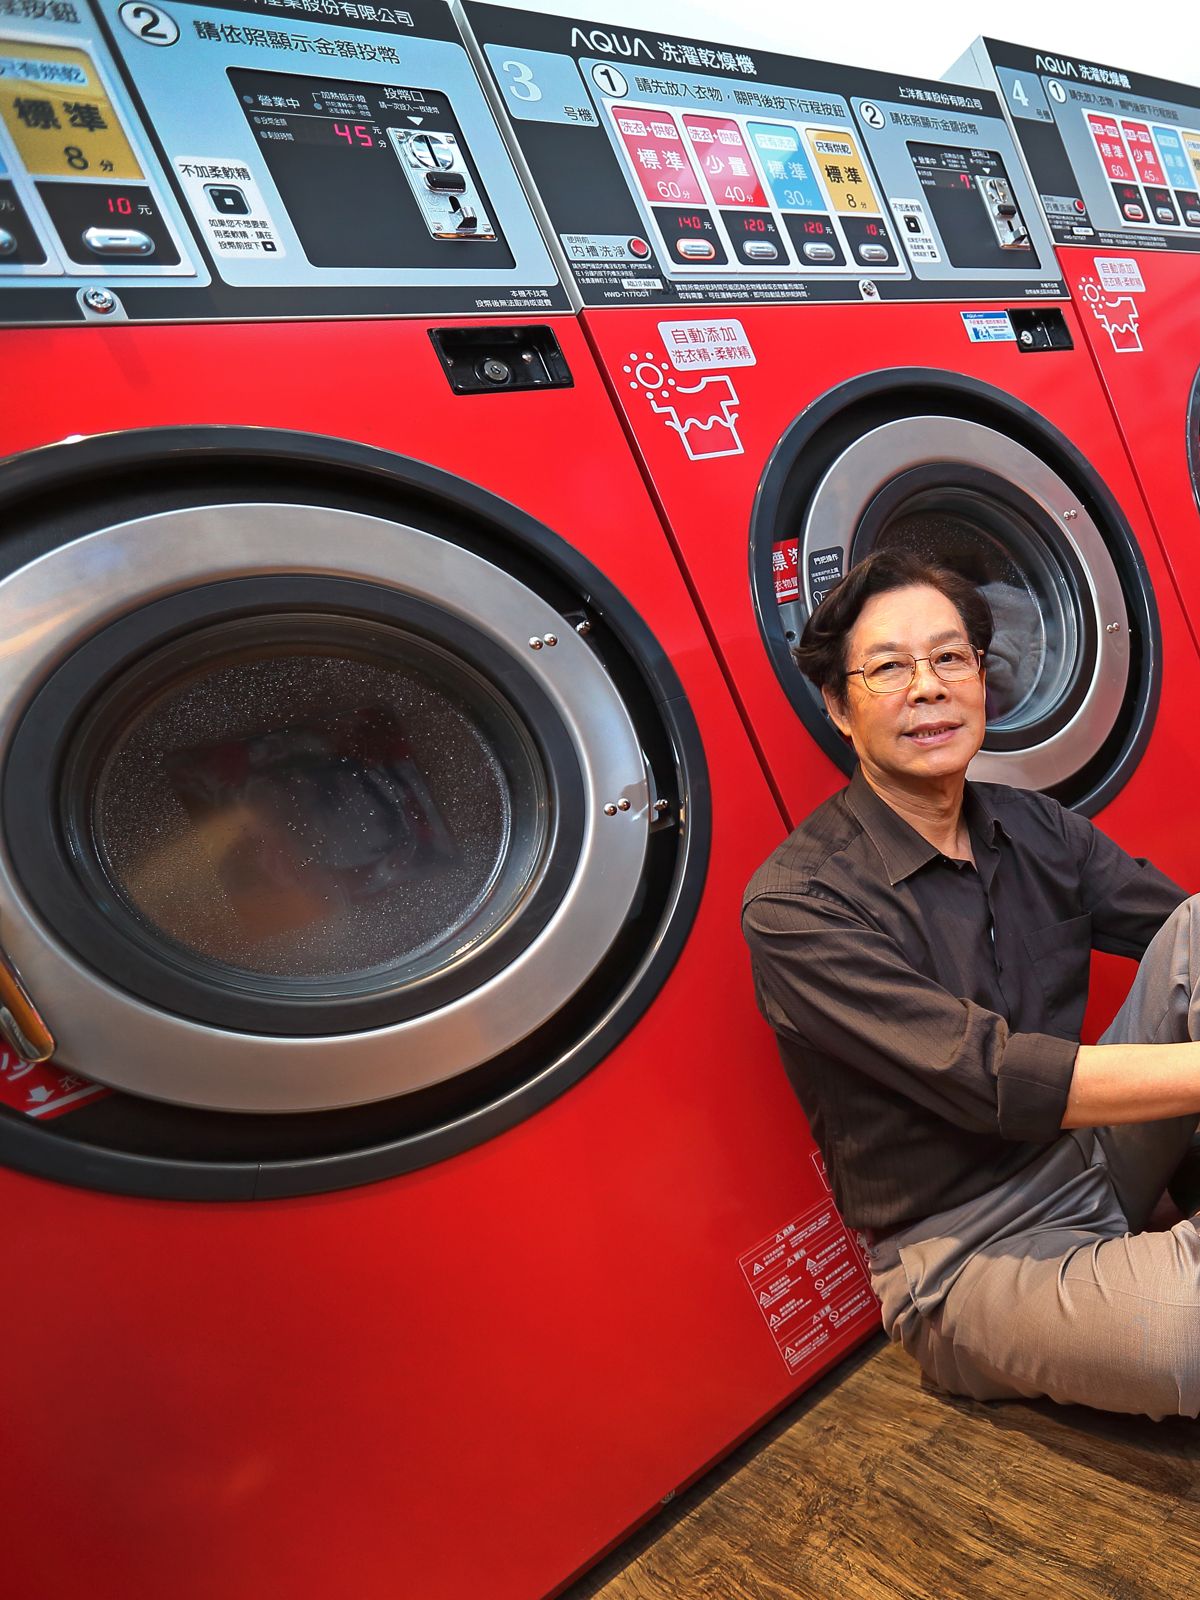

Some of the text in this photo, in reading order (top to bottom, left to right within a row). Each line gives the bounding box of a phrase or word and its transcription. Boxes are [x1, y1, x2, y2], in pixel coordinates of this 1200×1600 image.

[133, 7, 401, 65] 2 請依照顯示金額投幣
[571, 27, 758, 75] AQUA 洗濯乾燥機
[502, 60, 543, 101] 3
[1036, 54, 1131, 89] AQUA 洗濯乾燥機
[257, 94, 300, 109] 營業中
[383, 87, 426, 103] 投幣口
[1012, 79, 1029, 107] 4
[13, 97, 108, 131] 標準
[889, 111, 979, 136] 請依照顯示金額投幣
[334, 123, 373, 146] 45
[64, 146, 89, 170] 8
[637, 148, 686, 172] 標準
[706, 156, 750, 177] 少量
[179, 164, 251, 180] 不加柔軟精
[825, 165, 862, 184] 標準
[108, 198, 152, 215] 10 元
[671, 326, 737, 344] 自動添加
